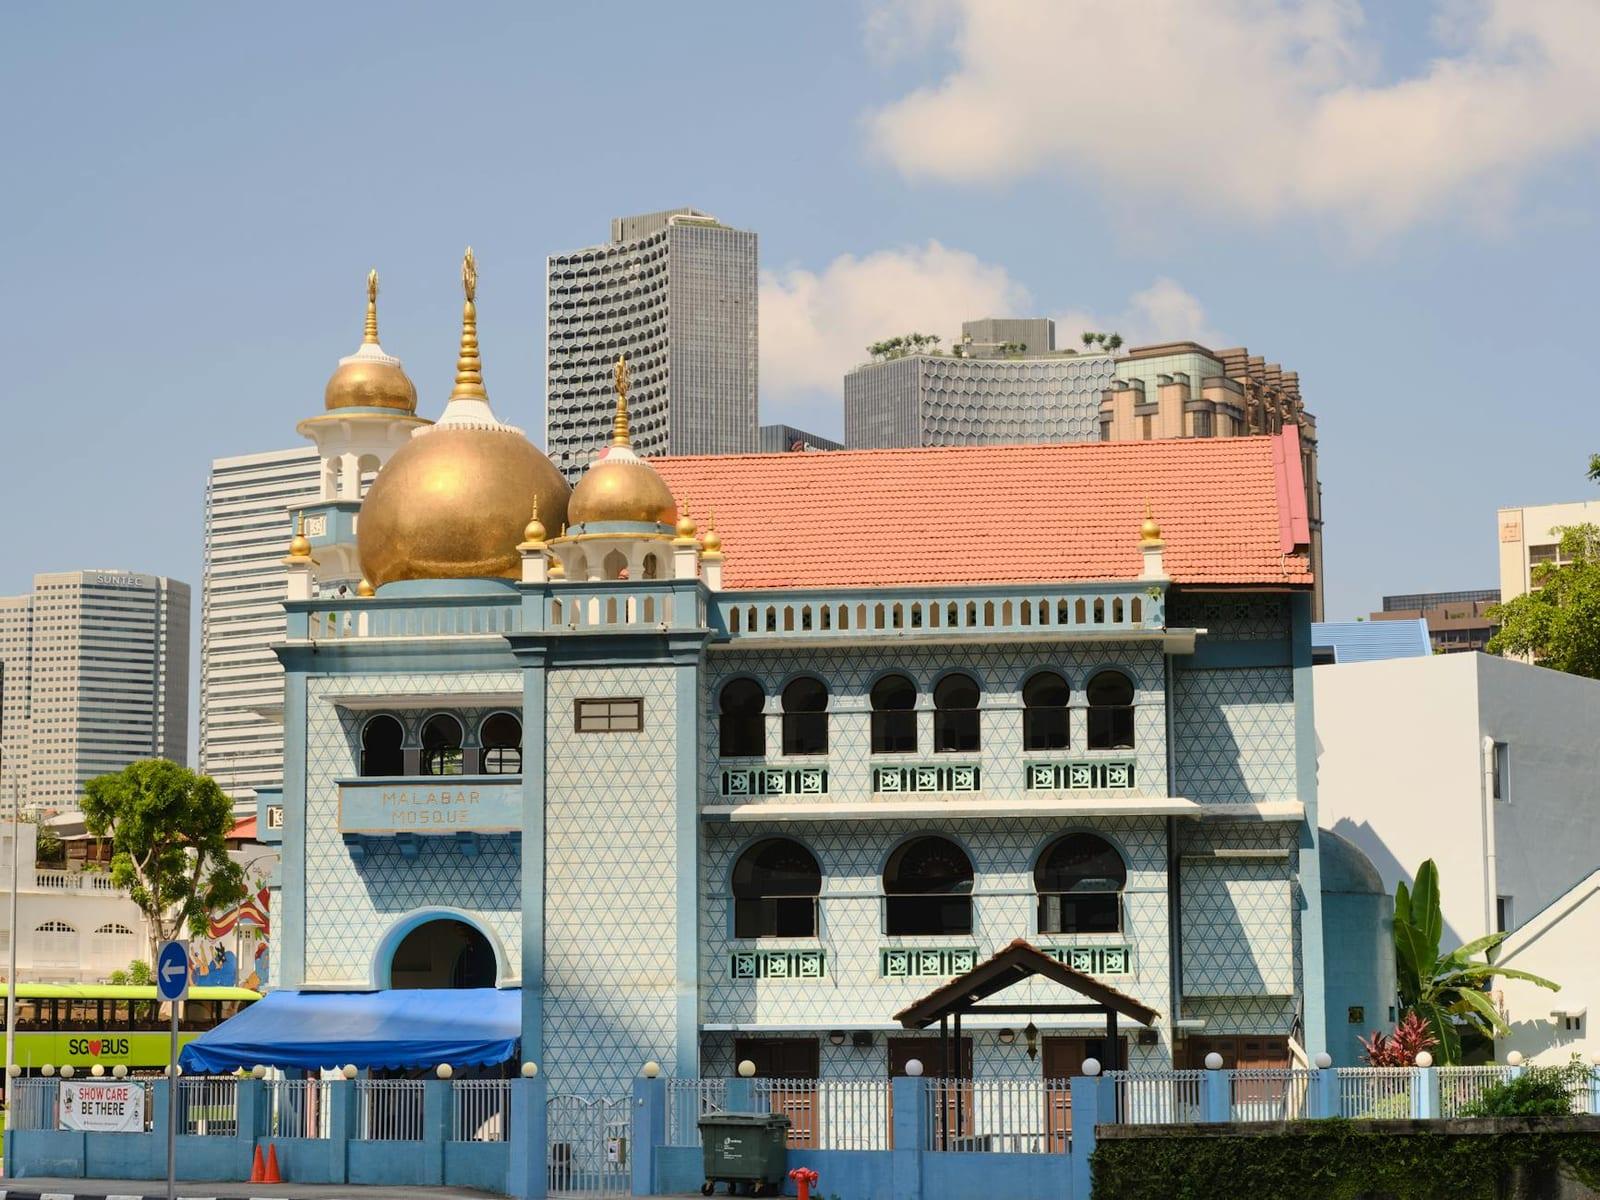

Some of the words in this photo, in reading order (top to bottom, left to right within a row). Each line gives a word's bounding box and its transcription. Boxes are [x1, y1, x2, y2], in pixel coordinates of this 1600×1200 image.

[97, 575, 143, 586] SUNTEC
[383, 791, 481, 806] MALABAR
[392, 809, 471, 825] MOSQUE
[79, 1088, 103, 1100] SHOW
[106, 1088, 128, 1101] CARE
[81, 1102, 93, 1115] BE
[95, 1102, 125, 1116] THERE
